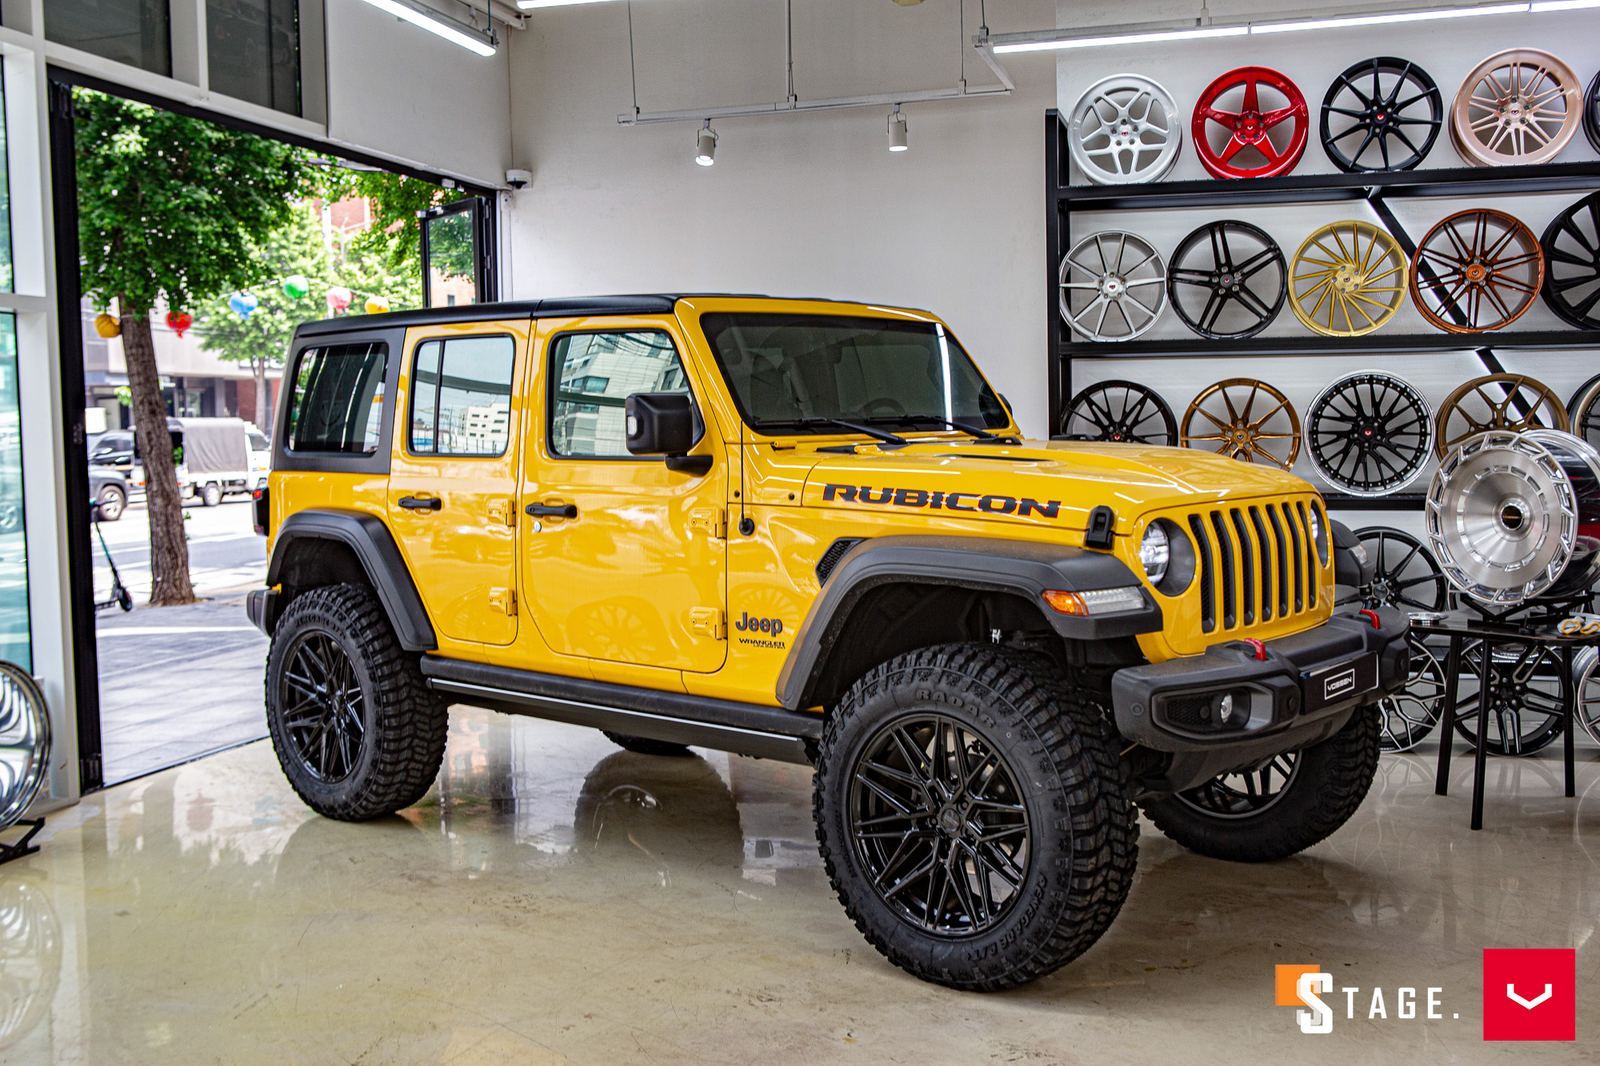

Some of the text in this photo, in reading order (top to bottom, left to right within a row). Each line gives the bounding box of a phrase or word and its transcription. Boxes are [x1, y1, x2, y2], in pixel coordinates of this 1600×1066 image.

[823, 483, 1061, 518] RUBICON
[735, 611, 783, 637] Jeep
[1327, 676, 1353, 691] VOSSEN
[915, 687, 997, 729] RADAR
